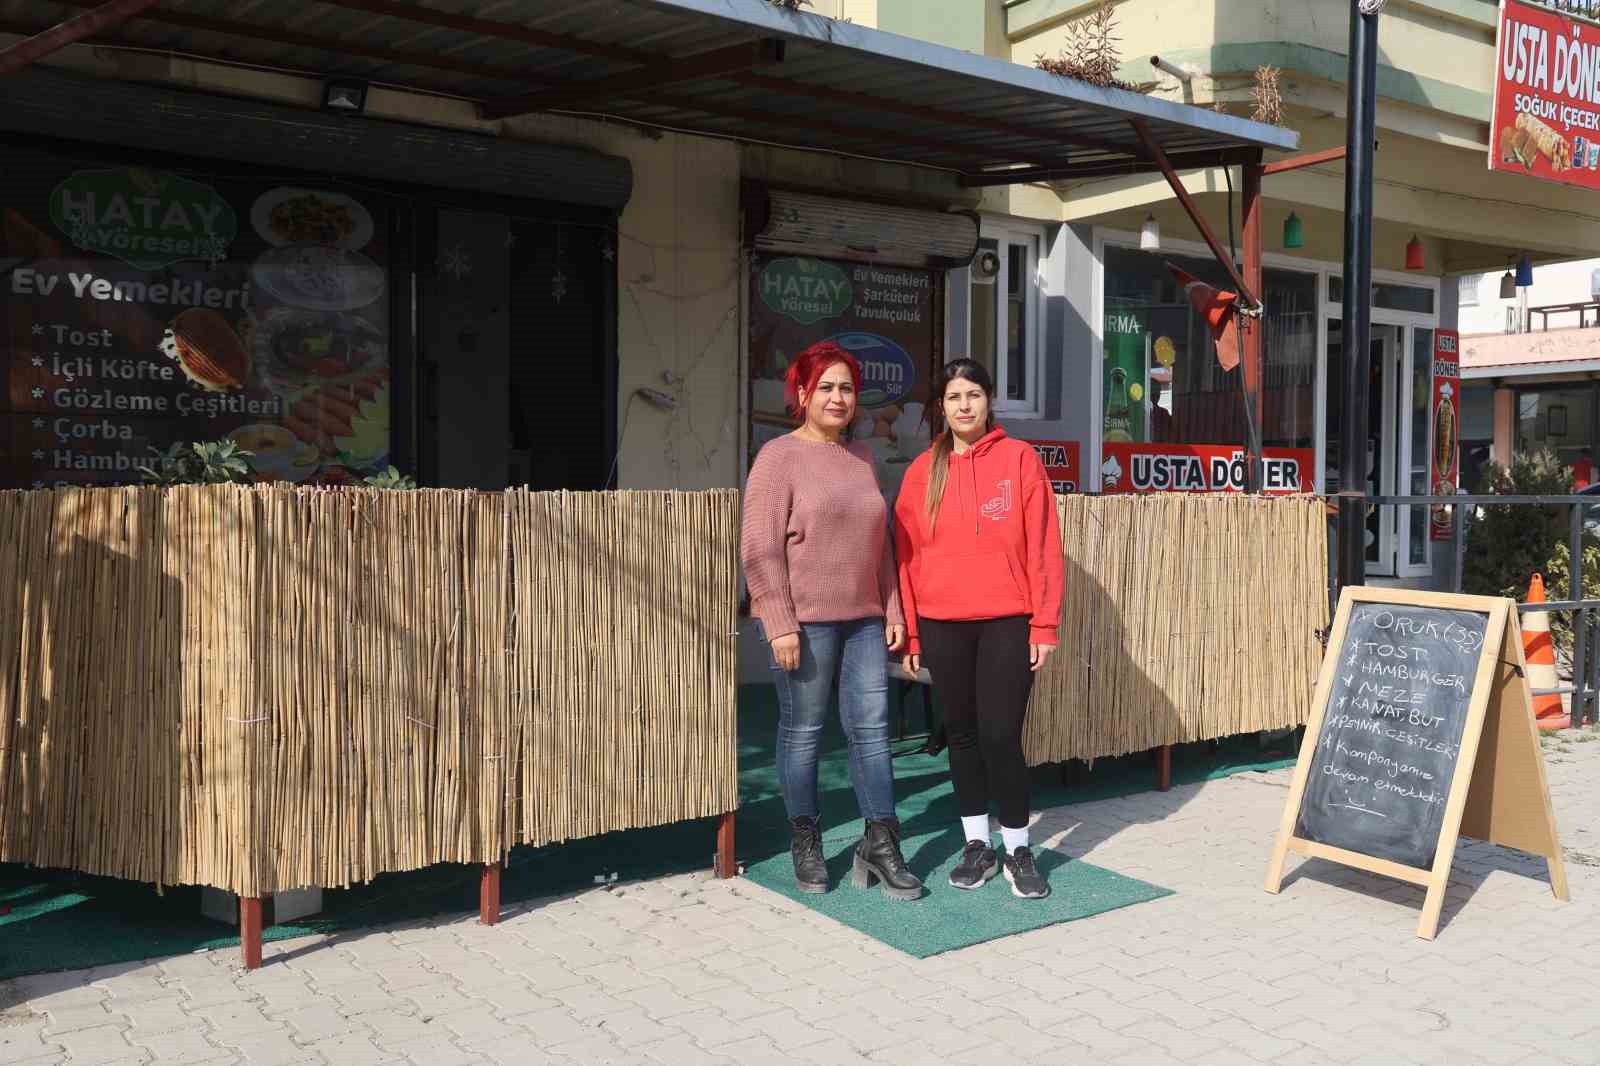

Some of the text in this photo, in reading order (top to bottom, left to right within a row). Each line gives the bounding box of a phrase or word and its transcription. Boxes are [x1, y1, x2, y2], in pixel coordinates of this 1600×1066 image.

[1503, 18, 1549, 92] USTA
[1514, 93, 1557, 121] SOĞUK
[62, 190, 224, 237] HATAY
[12, 268, 249, 310] Ev Yemekleri
[764, 271, 848, 302] HATAY
[853, 268, 929, 289] Ev Yemekleri
[863, 288, 918, 306] Şarküteri
[854, 304, 921, 324] Tavukçuluk
[1103, 314, 1143, 334] IRMA
[52, 324, 113, 348] Tost
[1438, 335, 1457, 352] USTA
[53, 353, 175, 382] İçli Köfte
[1433, 358, 1458, 377] DÖNER
[53, 388, 281, 418] Gözleme Çeşitleri
[54, 418, 133, 443] Çorba
[1032, 445, 1070, 468] TA
[1131, 451, 1300, 491] USTA DÖER
[1374, 611, 1439, 640] ORUK
[1363, 642, 1428, 661] TOST
[1361, 661, 1465, 693] HAMBURGER
[1358, 681, 1427, 704] MEZE
[1408, 708, 1446, 729] BUT
[1322, 760, 1369, 784] devam
